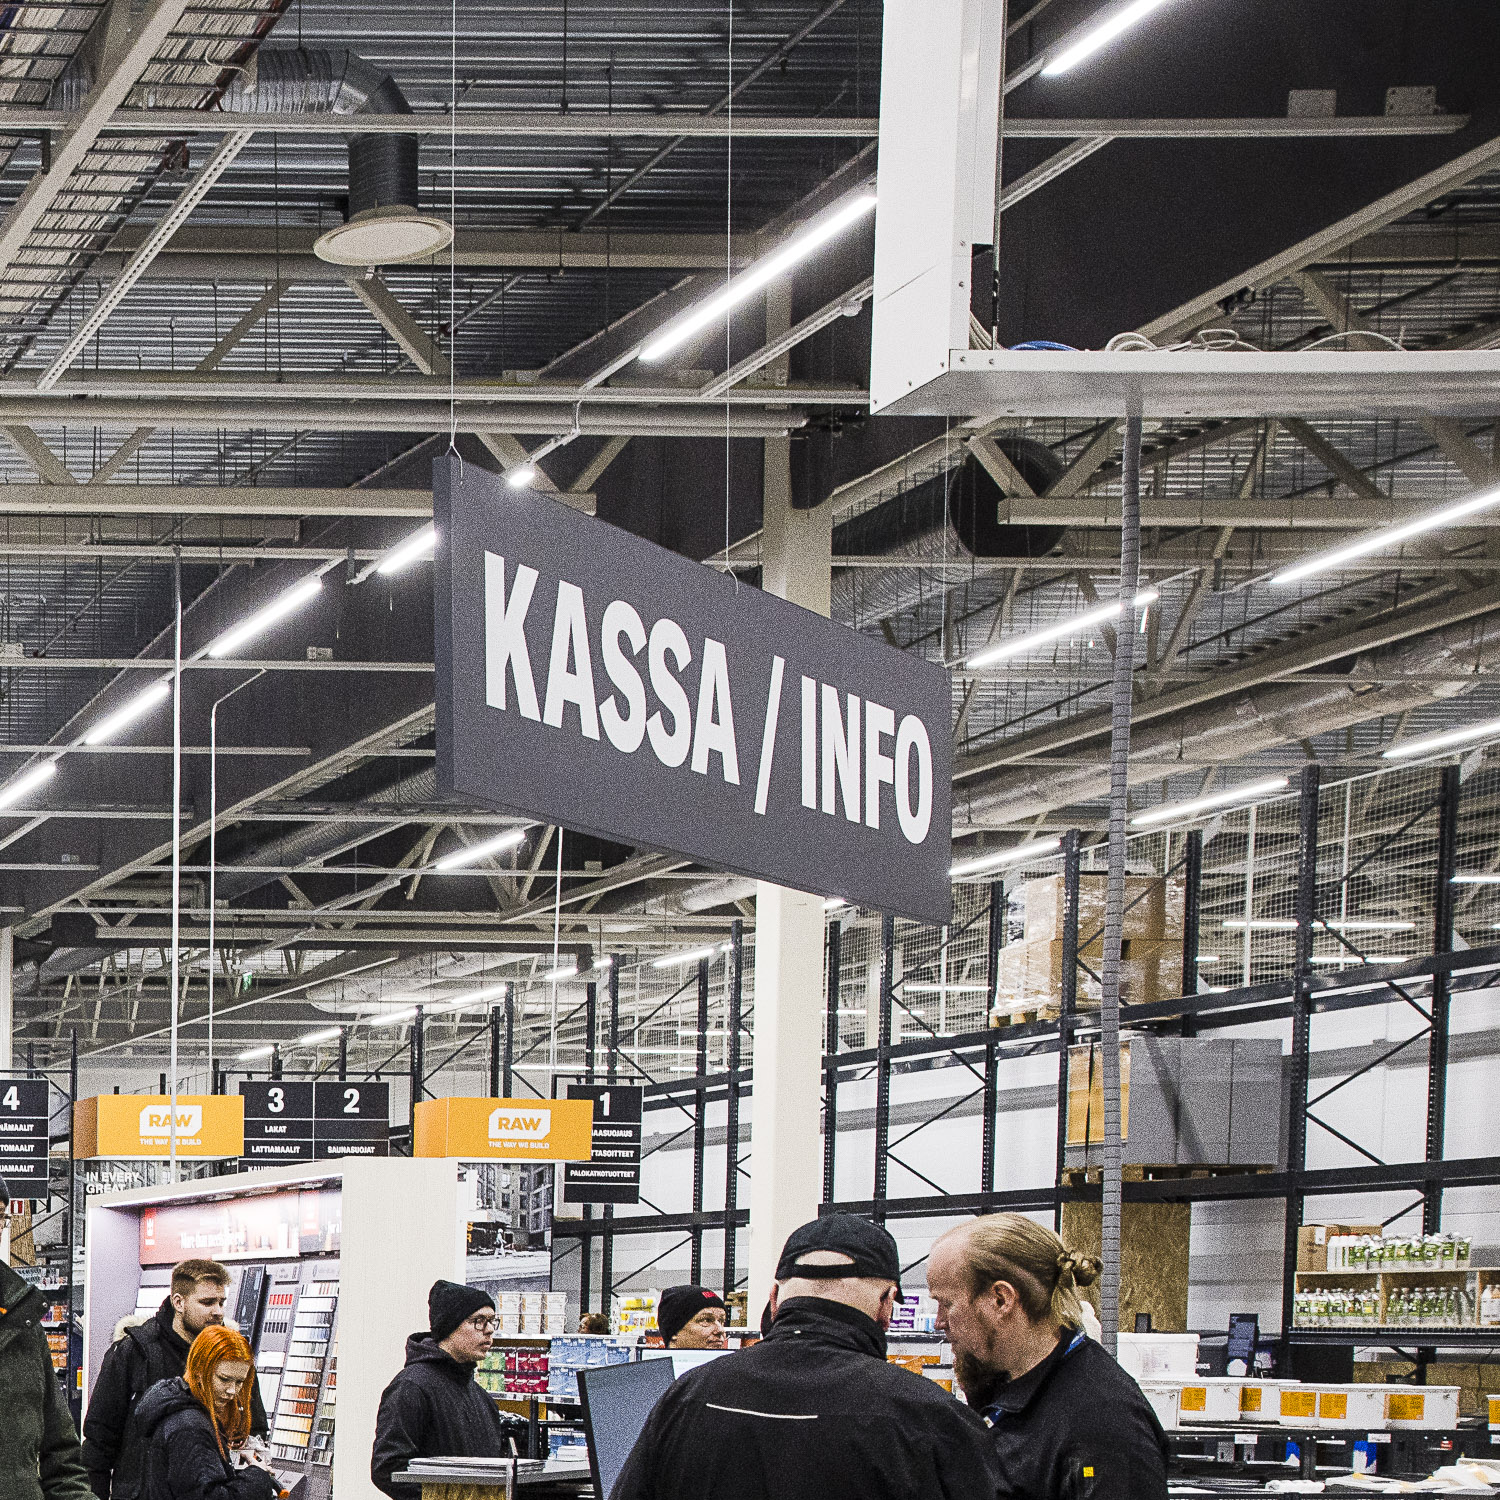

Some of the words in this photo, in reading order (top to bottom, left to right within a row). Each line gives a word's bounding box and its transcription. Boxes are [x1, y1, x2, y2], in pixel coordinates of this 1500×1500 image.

[484, 549, 741, 787] KASSA
[754, 655, 786, 816] /
[801, 674, 934, 845] INFO
[2, 1085, 21, 1111] 4
[267, 1087, 285, 1113] 3
[343, 1088, 361, 1114] 2
[599, 1091, 611, 1117] 1
[149, 1113, 193, 1128] RAW
[497, 1116, 542, 1131] RAW
[264, 1125, 288, 1133] LAKAT
[139, 1138, 153, 1146] THE
[153, 1138, 169, 1146] WAY
[488, 1140, 502, 1148] THE
[503, 1141, 518, 1149] WAY
[530, 1142, 550, 1150] BUILD
[86, 1171, 99, 1182] IN
[102, 1171, 139, 1183] EVERY
